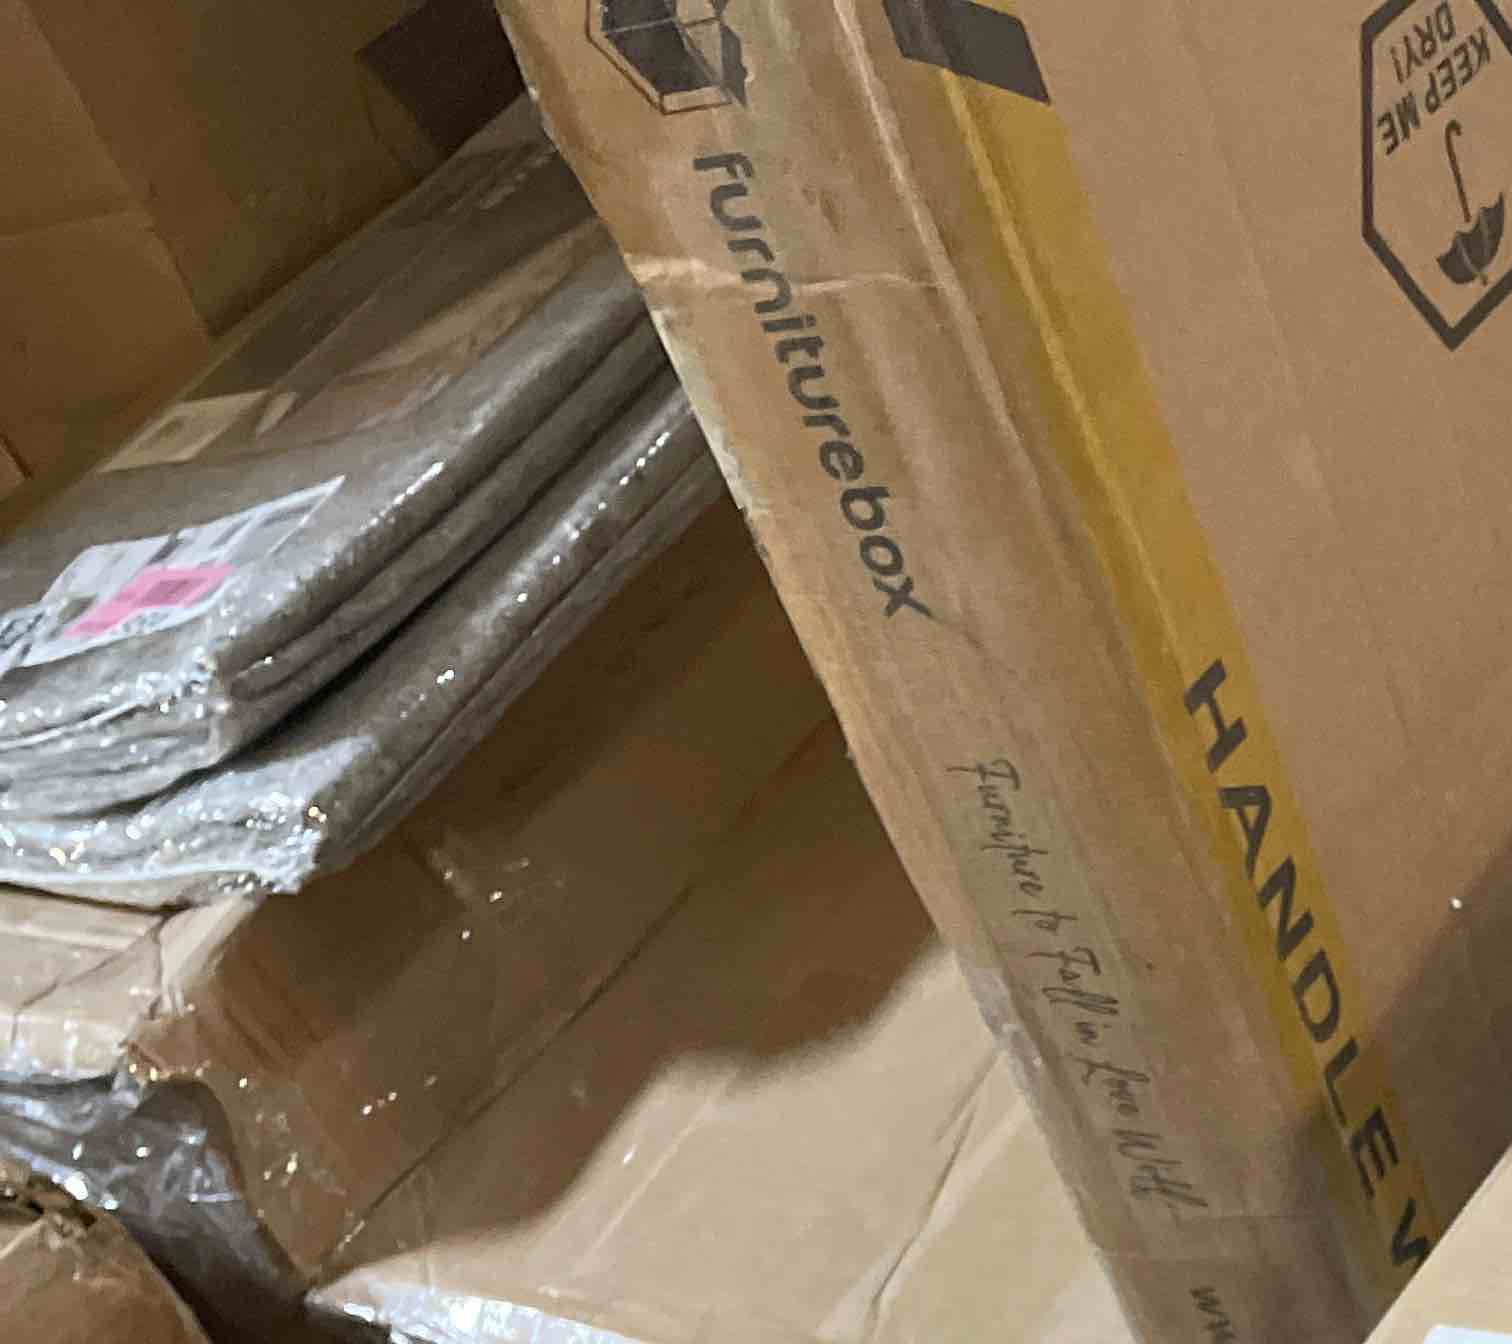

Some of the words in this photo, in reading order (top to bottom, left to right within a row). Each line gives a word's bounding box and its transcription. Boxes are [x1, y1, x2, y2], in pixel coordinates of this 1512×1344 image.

[1390, 2, 1456, 83] DRY!
[1425, 26, 1490, 114] KEEP
[1376, 90, 1421, 156] ME
[693, 151, 937, 620] furniturebox
[946, 759, 1049, 897] Furniture
[1012, 909, 1078, 934] to
[1184, 658, 1399, 1198] HANDLE
[1024, 946, 1119, 1015] Fall
